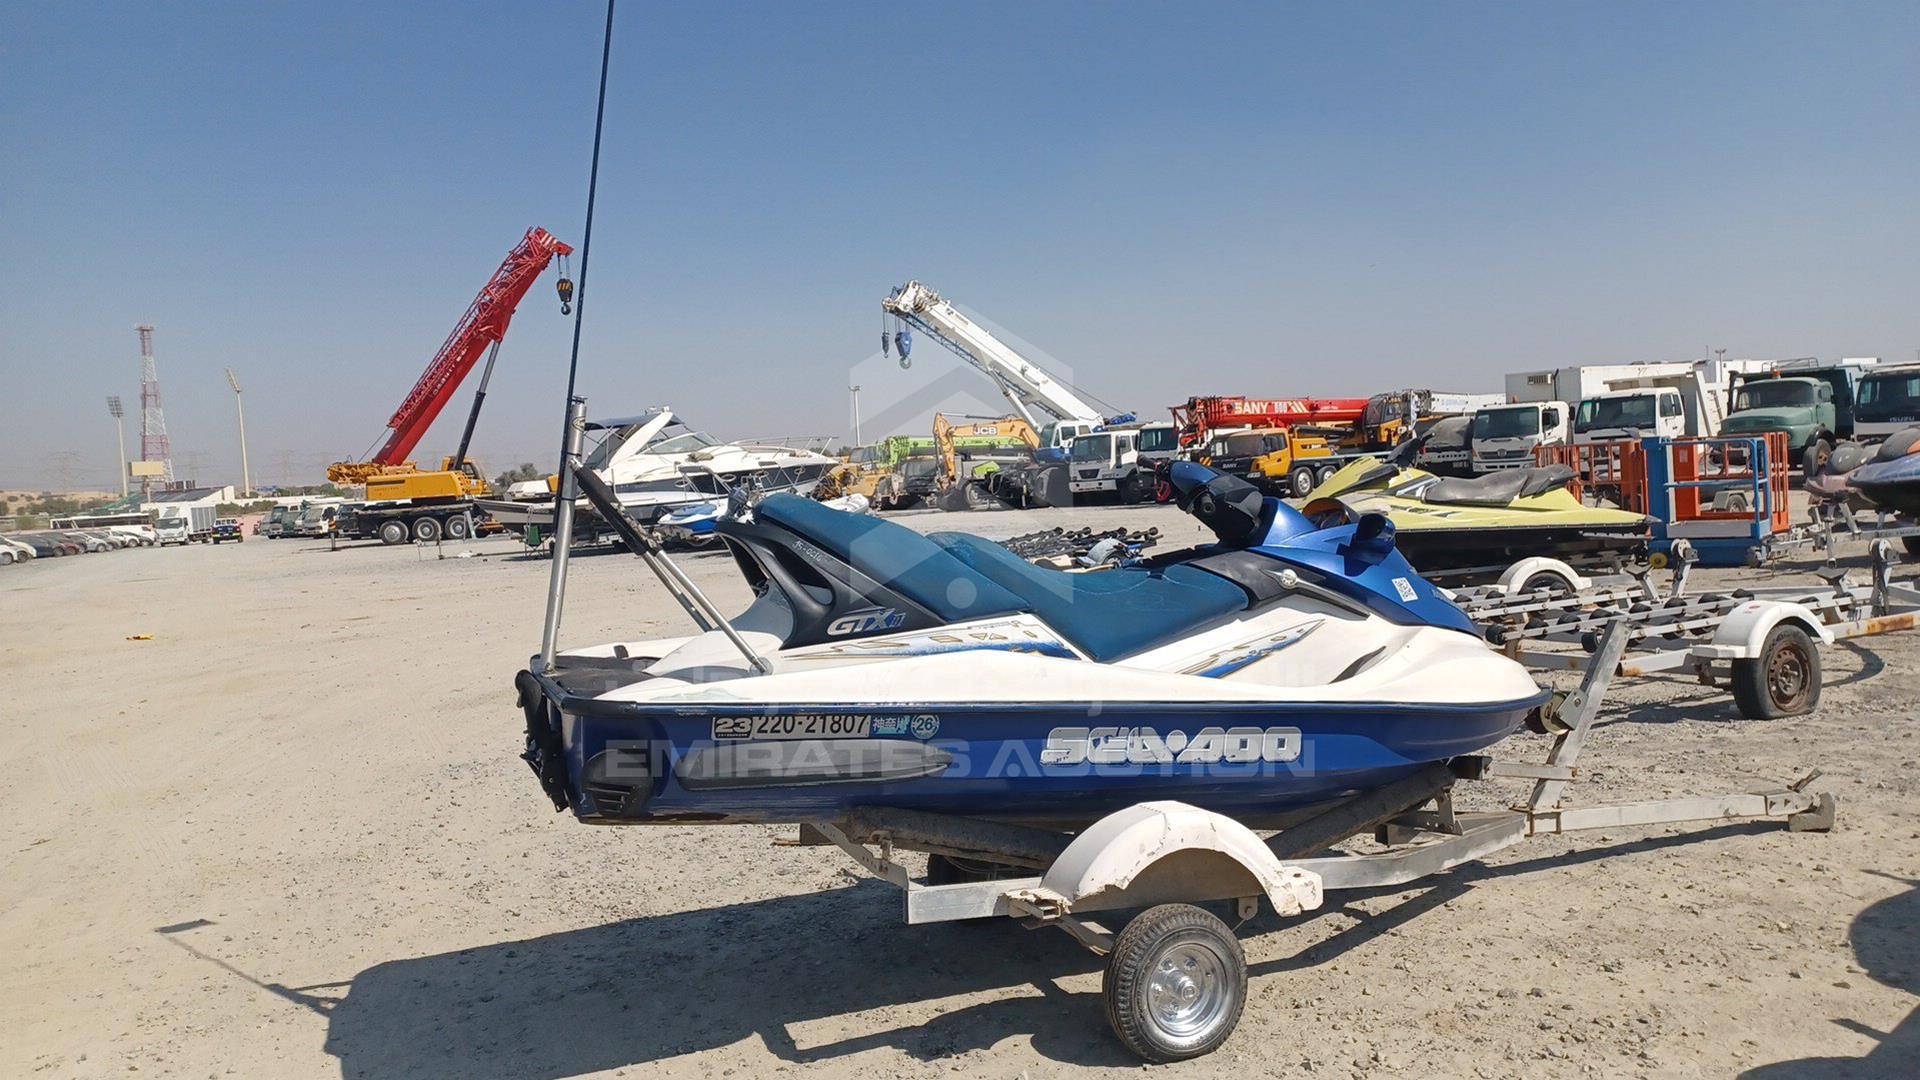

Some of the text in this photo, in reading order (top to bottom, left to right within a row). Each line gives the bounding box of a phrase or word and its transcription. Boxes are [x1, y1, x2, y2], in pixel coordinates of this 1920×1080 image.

[1234, 401, 1268, 414] SANY
[973, 427, 997, 435] JCB
[826, 608, 896, 637] GTX
[715, 715, 868, 734] 23 220-21807
[917, 717, 934, 731] 26
